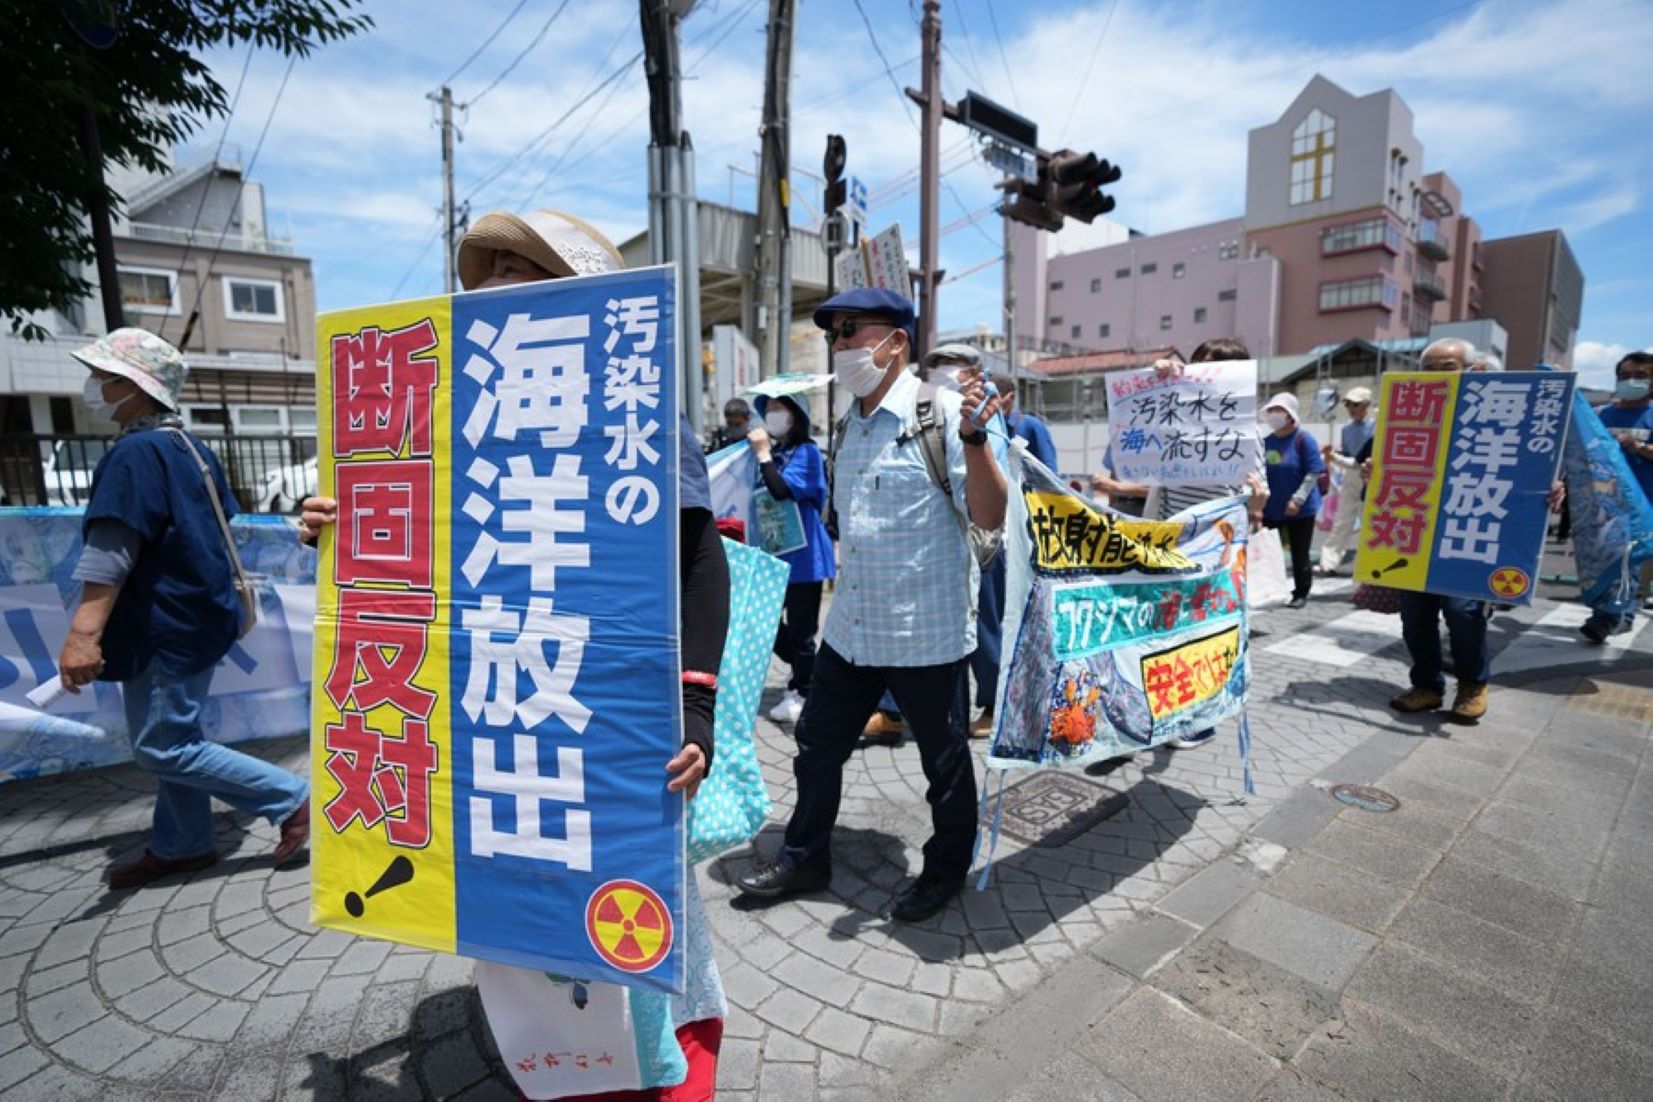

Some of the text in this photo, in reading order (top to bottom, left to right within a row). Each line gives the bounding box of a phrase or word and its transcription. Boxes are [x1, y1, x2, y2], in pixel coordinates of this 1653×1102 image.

[603, 295, 661, 525] 汚染水の
[1130, 391, 1238, 425] 汚染水を
[1367, 379, 1449, 579] 断固反対!
[1438, 380, 1532, 565] 海洋放出
[1527, 379, 1567, 453] 汚染水の
[323, 318, 439, 918] 断固反対!
[460, 313, 594, 872] 海洋放出
